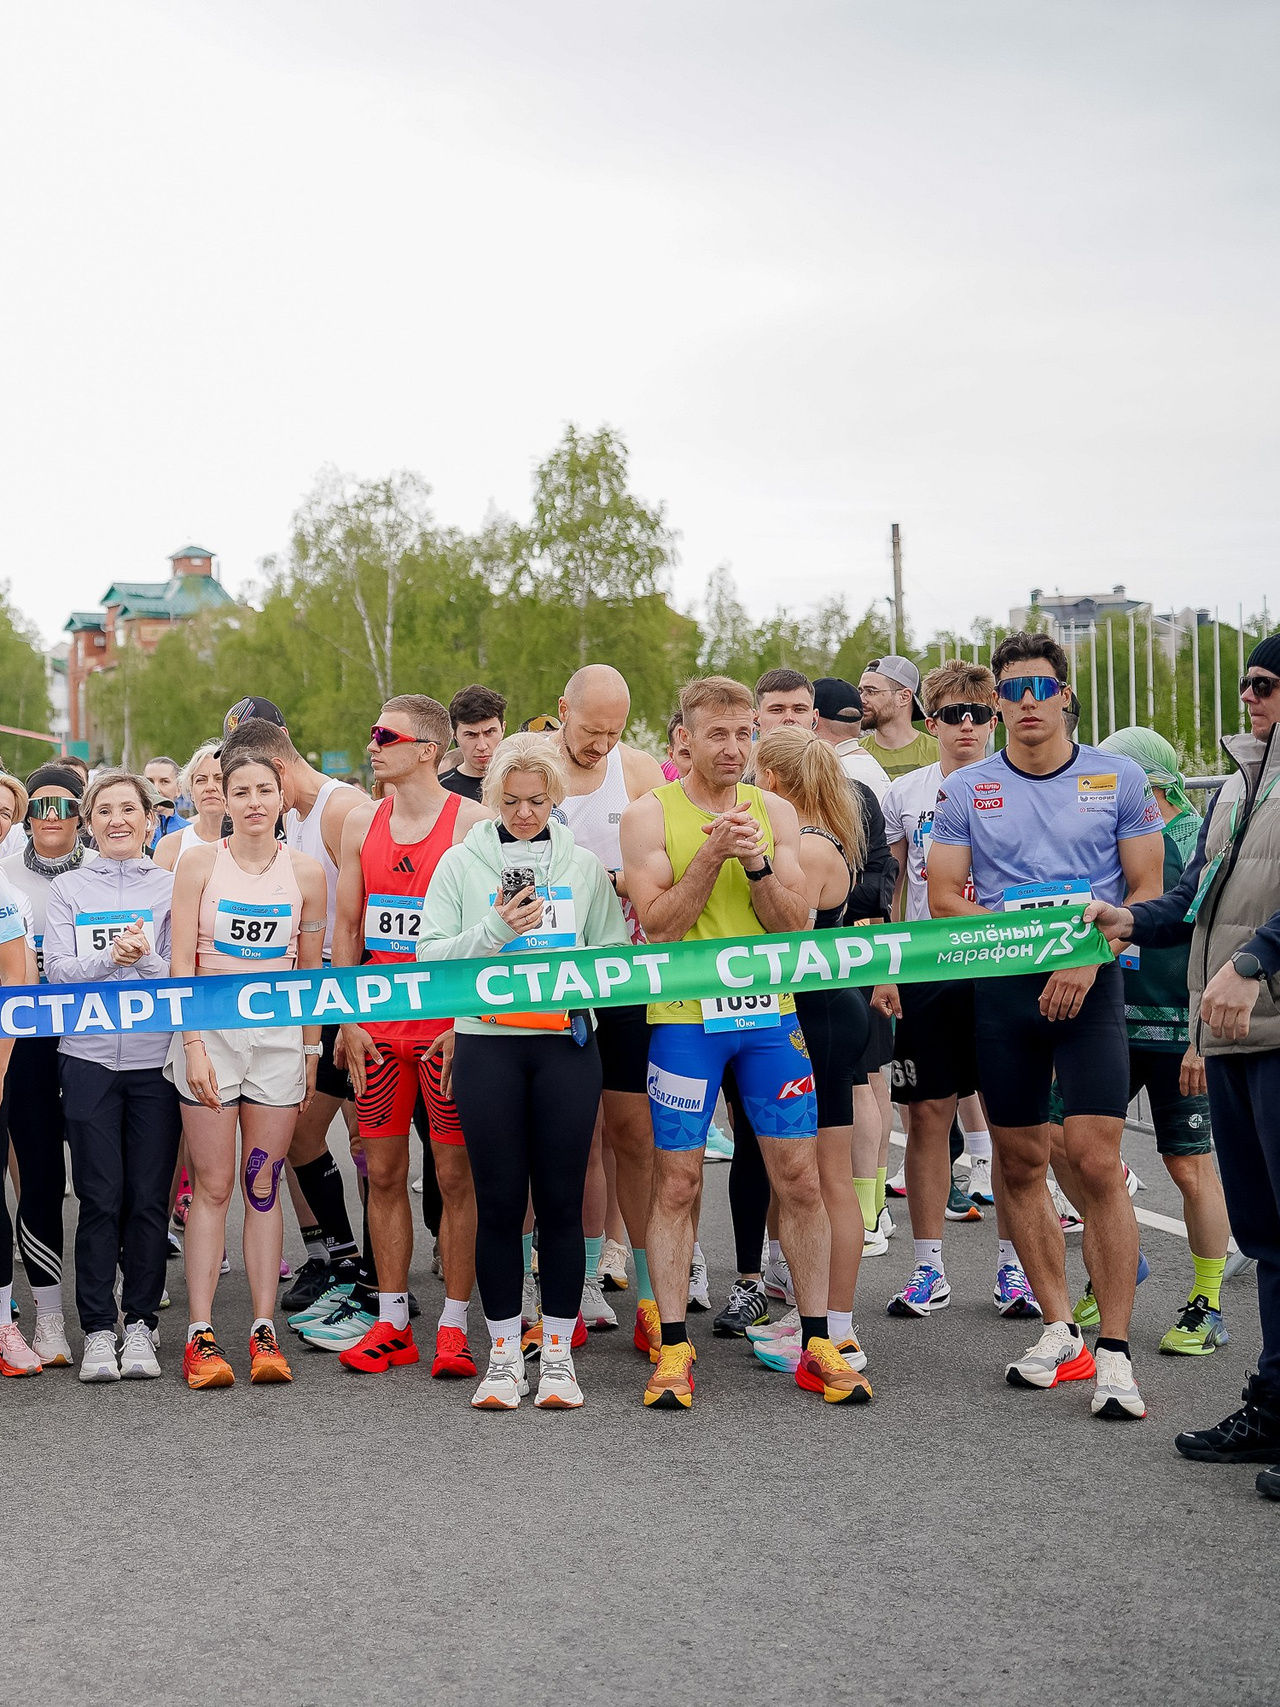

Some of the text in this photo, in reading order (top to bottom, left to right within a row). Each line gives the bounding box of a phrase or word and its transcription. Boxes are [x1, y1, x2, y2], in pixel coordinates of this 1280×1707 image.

[230, 918, 278, 942] 587
[379, 911, 421, 937] 812
[949, 920, 1044, 945] зелёный
[715, 932, 912, 988] СТАРТ
[937, 942, 1033, 965] марафон
[475, 953, 670, 1005] СТАРТ
[237, 971, 431, 1020] СТАРТ
[713, 993, 772, 1013] 1055
[0, 987, 193, 1036] СТАРТ
[891, 1059, 917, 1087] 69
[656, 1089, 701, 1110] GAZPROM
